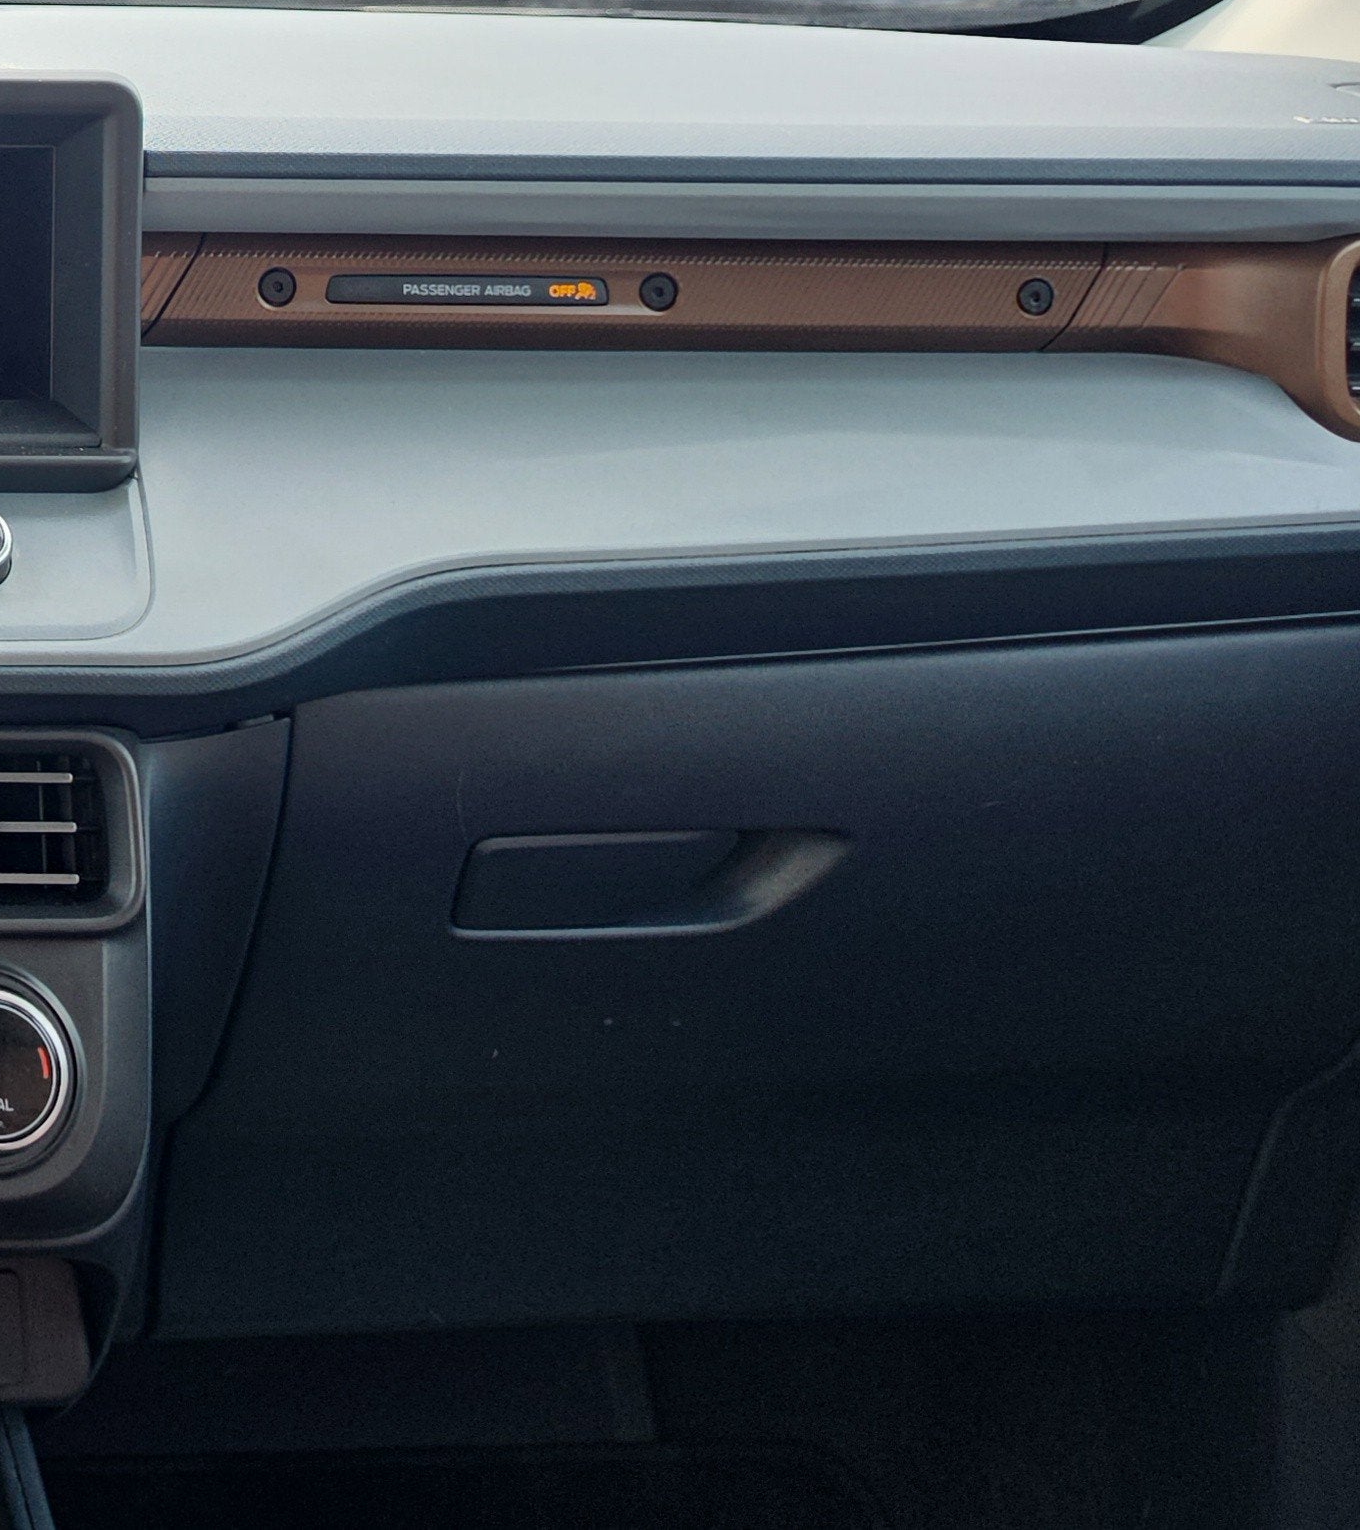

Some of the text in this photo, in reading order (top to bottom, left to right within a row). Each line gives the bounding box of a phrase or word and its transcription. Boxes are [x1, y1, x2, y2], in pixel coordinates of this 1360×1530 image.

[402, 283, 576, 298] PASSENGER AIRBAG OFF
